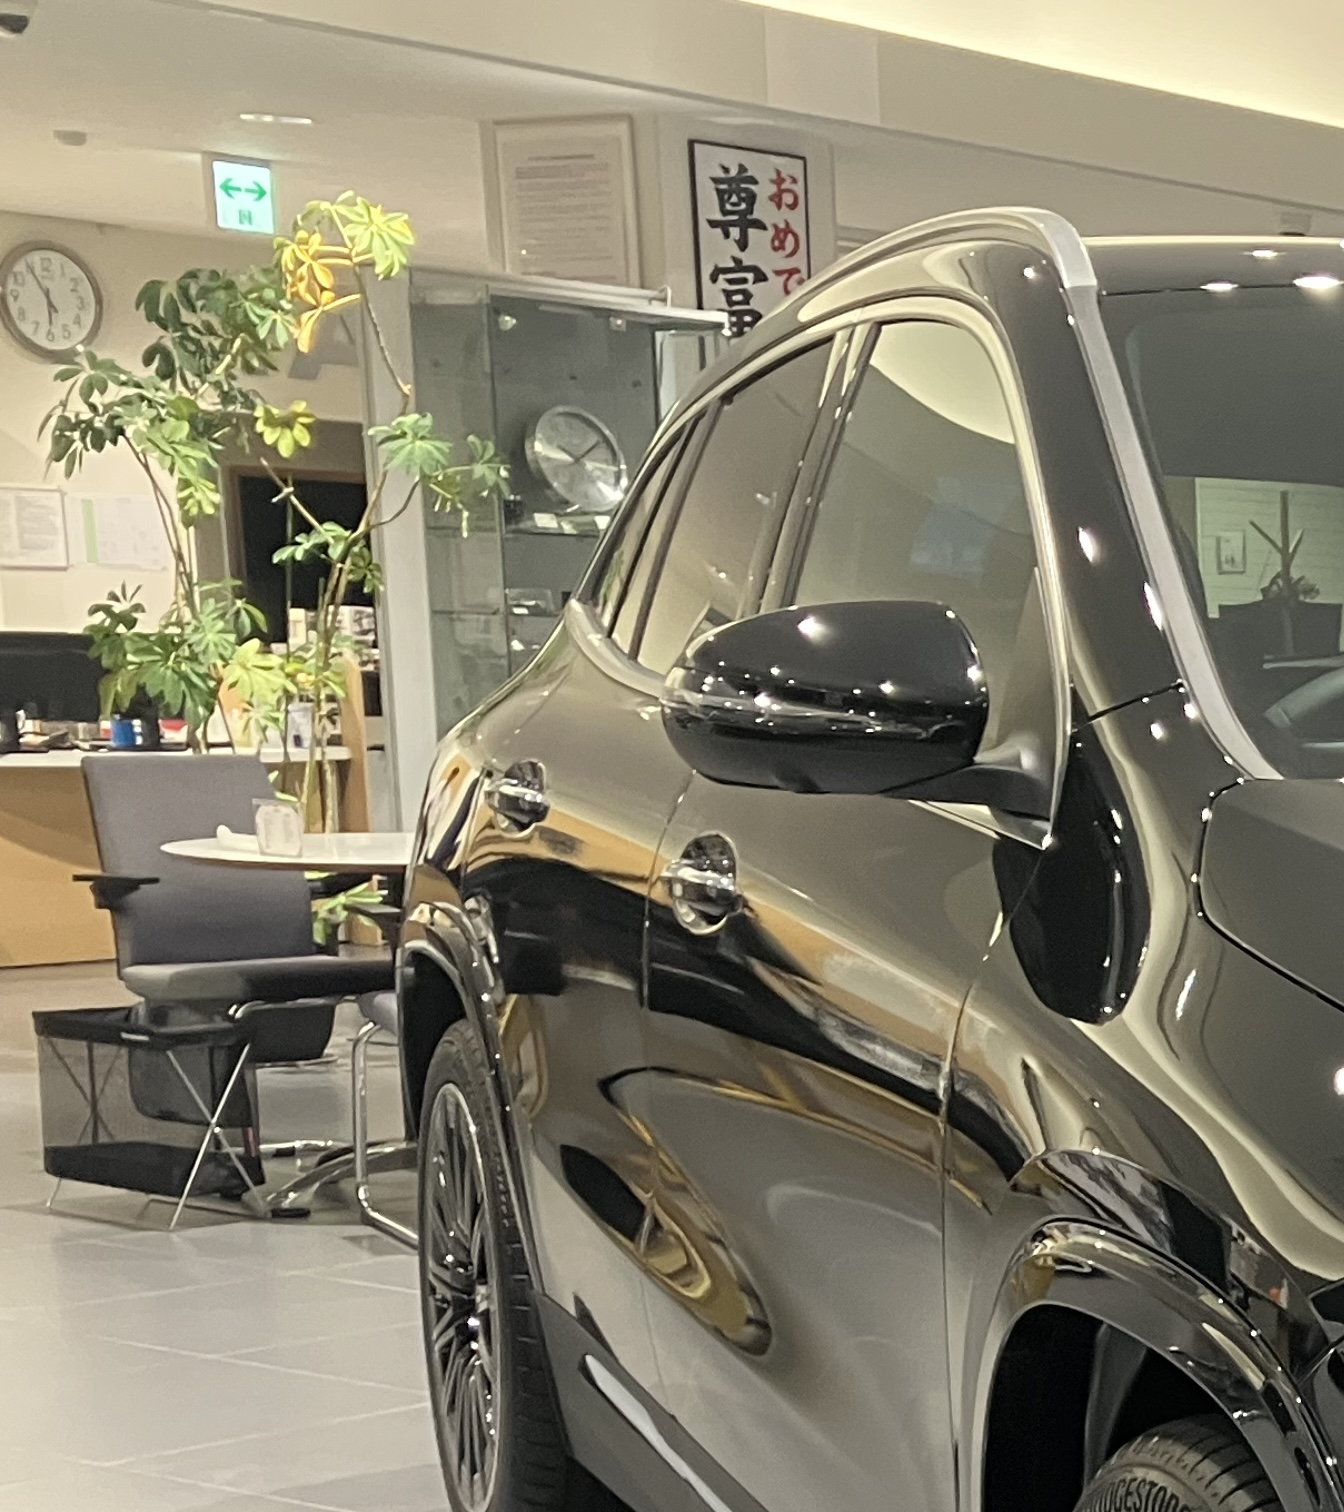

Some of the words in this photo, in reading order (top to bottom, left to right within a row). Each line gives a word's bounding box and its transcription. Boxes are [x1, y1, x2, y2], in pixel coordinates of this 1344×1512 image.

[31, 320, 40, 336] 7
[46, 327, 55, 342] 6
[62, 324, 71, 339] 5
